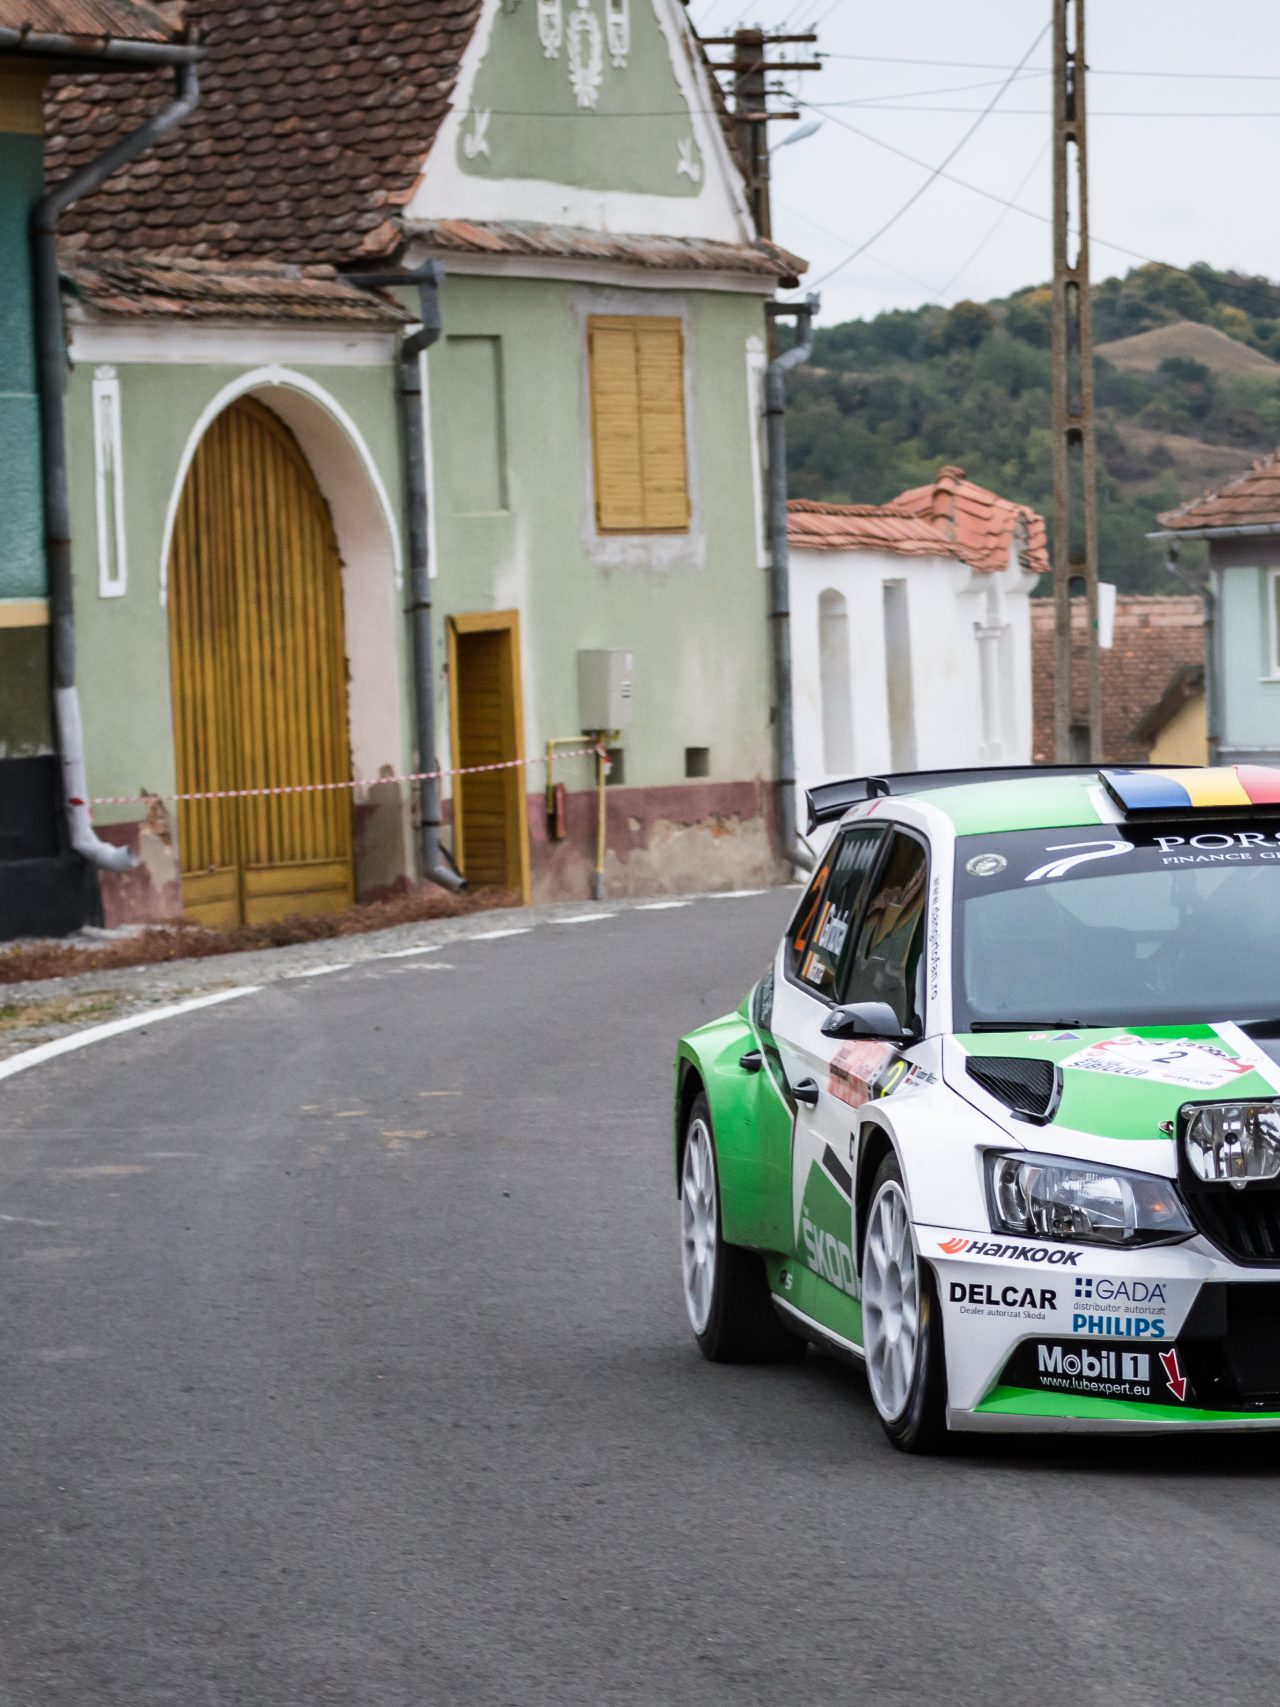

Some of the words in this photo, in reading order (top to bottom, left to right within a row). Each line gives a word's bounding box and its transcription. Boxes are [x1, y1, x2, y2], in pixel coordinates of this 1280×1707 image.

[1162, 853, 1252, 865] FINANCE
[1151, 1050, 1188, 1064] 2
[802, 1205, 862, 1301] ŠKOD
[949, 1282, 1058, 1310] DELCAR
[959, 1305, 984, 1315] Dealer
[986, 1308, 1021, 1319] autorizat
[1022, 1310, 1046, 1321] Skoda
[1073, 1301, 1122, 1313] distribuitor
[1123, 1305, 1166, 1316] autorizat
[1072, 1313, 1166, 1339] PHILIPS
[1037, 1344, 1116, 1380] Mobil
[1039, 1375, 1150, 1397] www.lubexpert.eu
